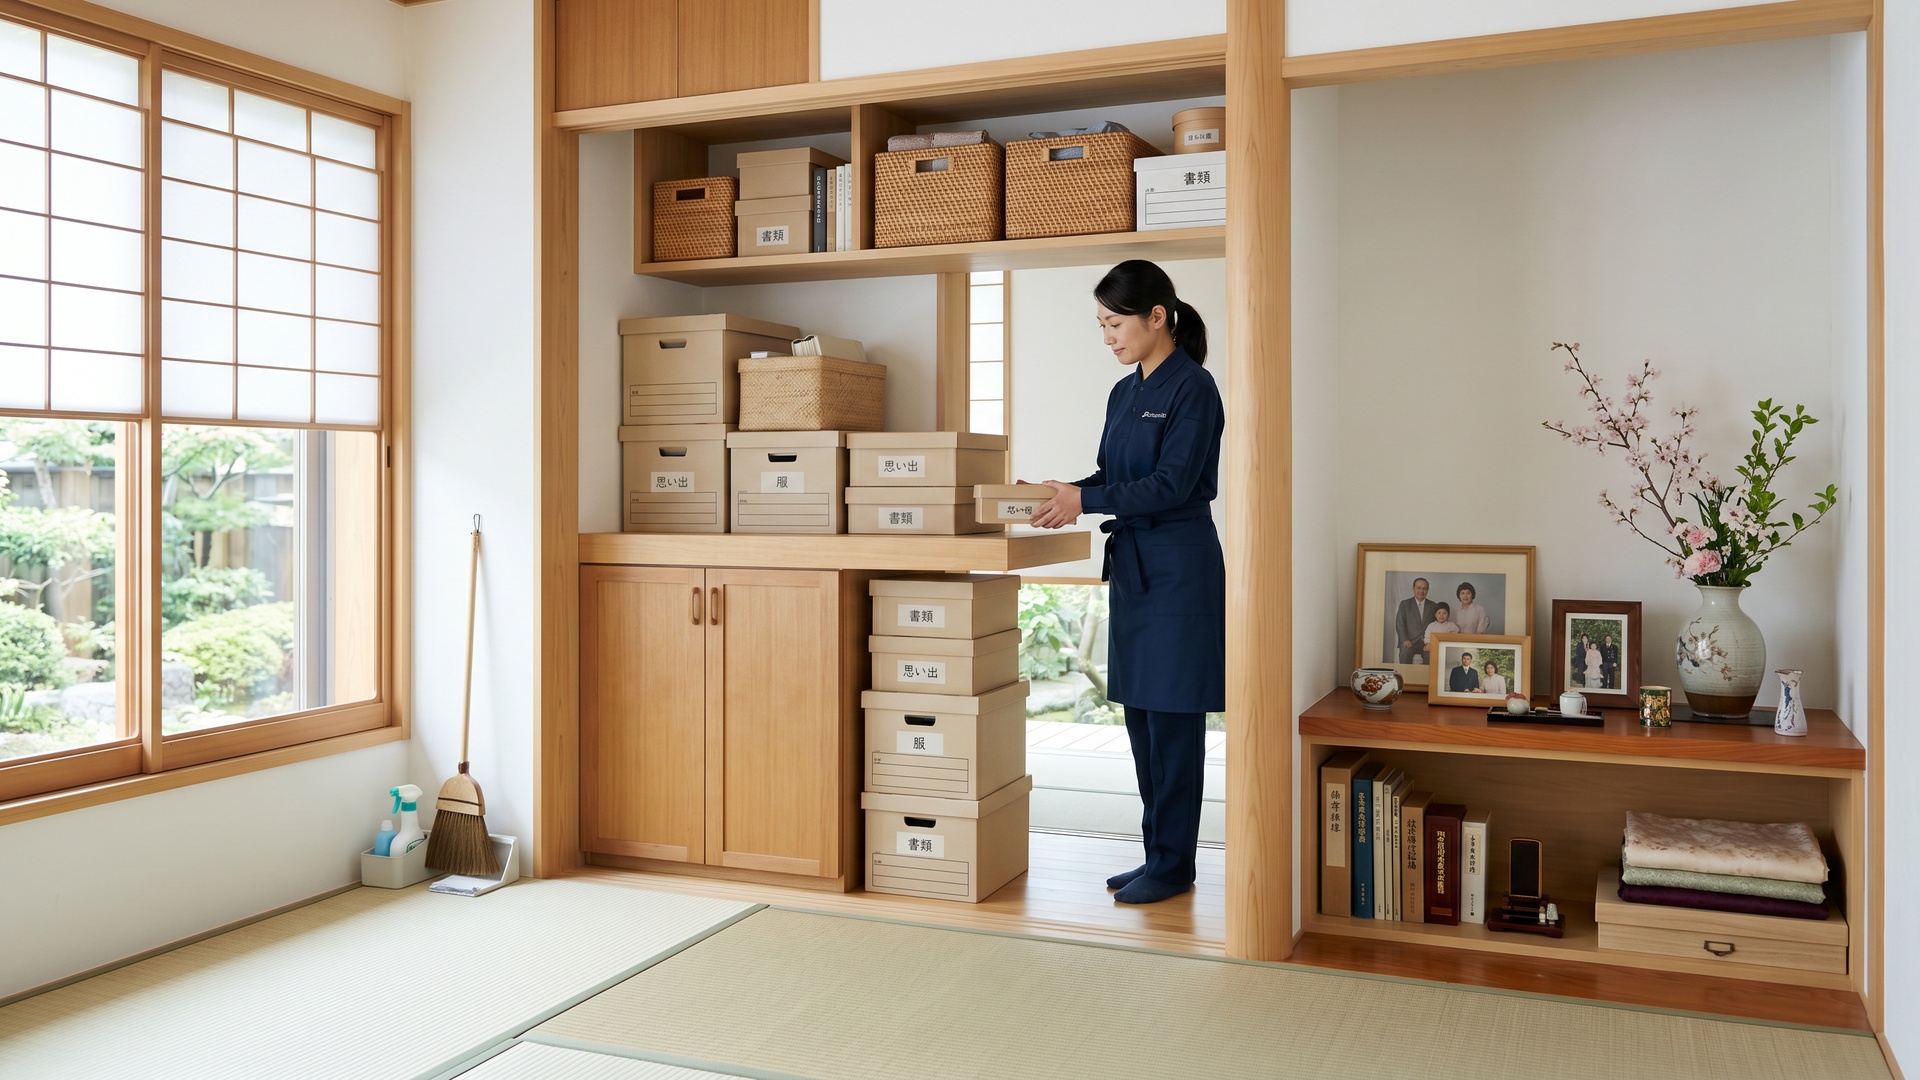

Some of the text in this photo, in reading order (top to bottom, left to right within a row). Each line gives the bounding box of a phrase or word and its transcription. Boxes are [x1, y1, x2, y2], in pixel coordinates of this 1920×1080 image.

[1183, 170, 1211, 186] 書類
[761, 229, 784, 242] 書類
[883, 459, 918, 473] 思い出
[655, 475, 688, 489] 思い出
[776, 475, 789, 489] 服
[888, 511, 913, 525] 書類
[909, 609, 934, 623] 書類
[903, 664, 938, 679] 思い出
[913, 736, 926, 751] 服
[907, 837, 933, 853] 書類
